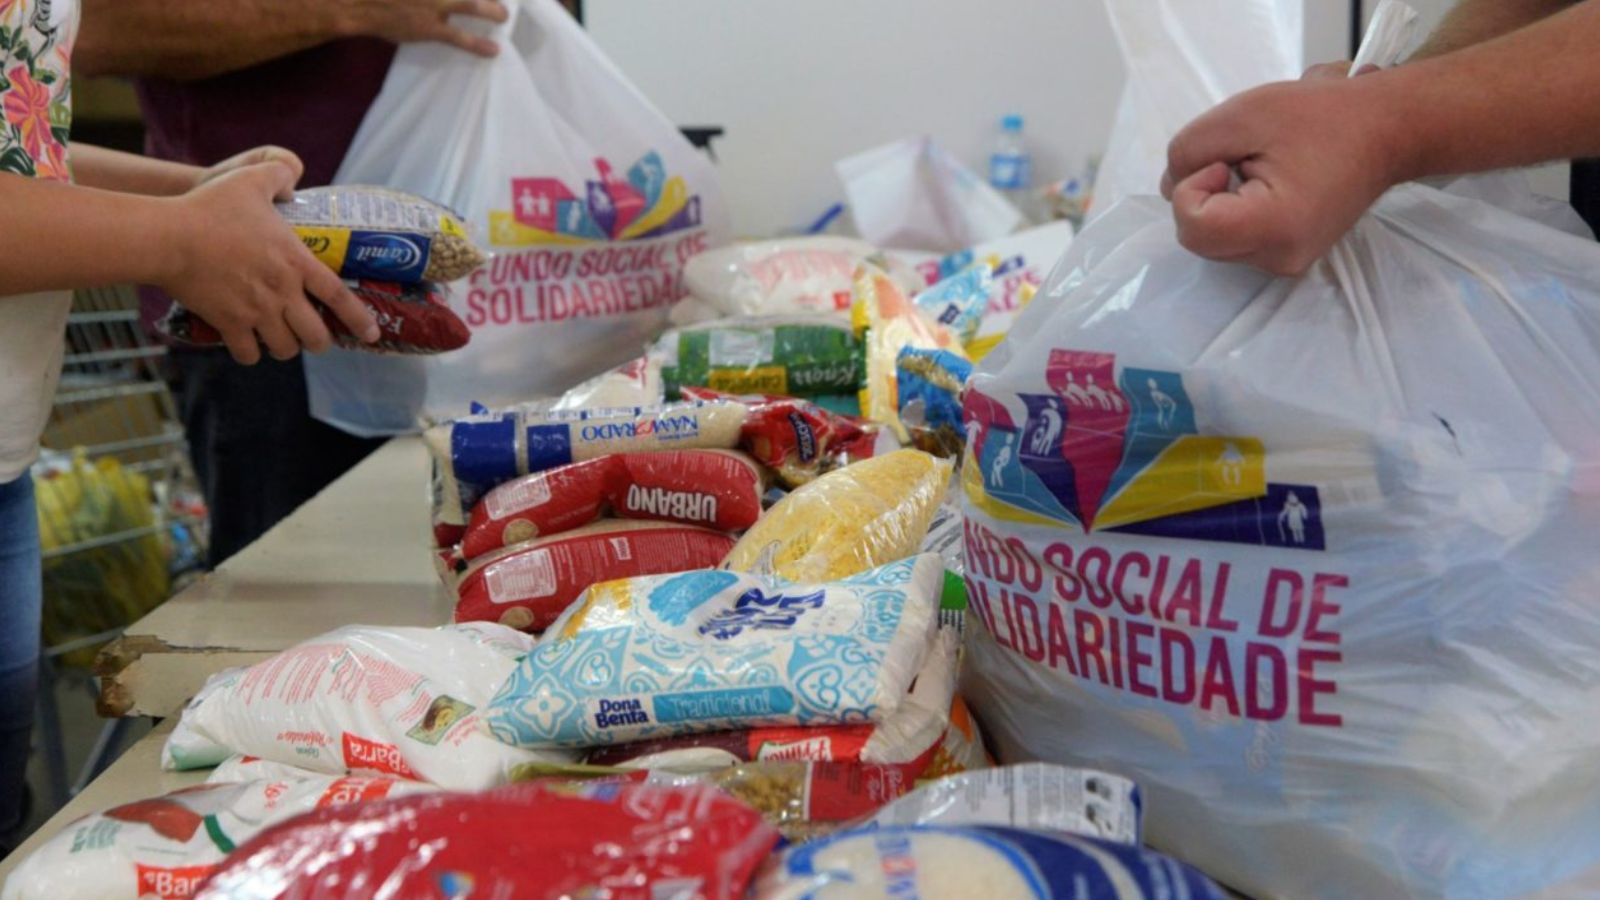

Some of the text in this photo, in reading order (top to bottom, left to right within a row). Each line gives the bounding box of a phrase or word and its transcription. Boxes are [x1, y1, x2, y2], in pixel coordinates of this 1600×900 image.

[356, 244, 412, 263] Camil
[576, 242, 676, 279] SOCIAL
[627, 484, 717, 522] URBANO
[1043, 542, 1238, 632] SOCIAL
[1258, 567, 1350, 645] DE
[599, 698, 642, 713] Dona
[670, 689, 771, 718] Tradicional
[595, 709, 649, 729] Benta
[351, 741, 401, 773] Barra
